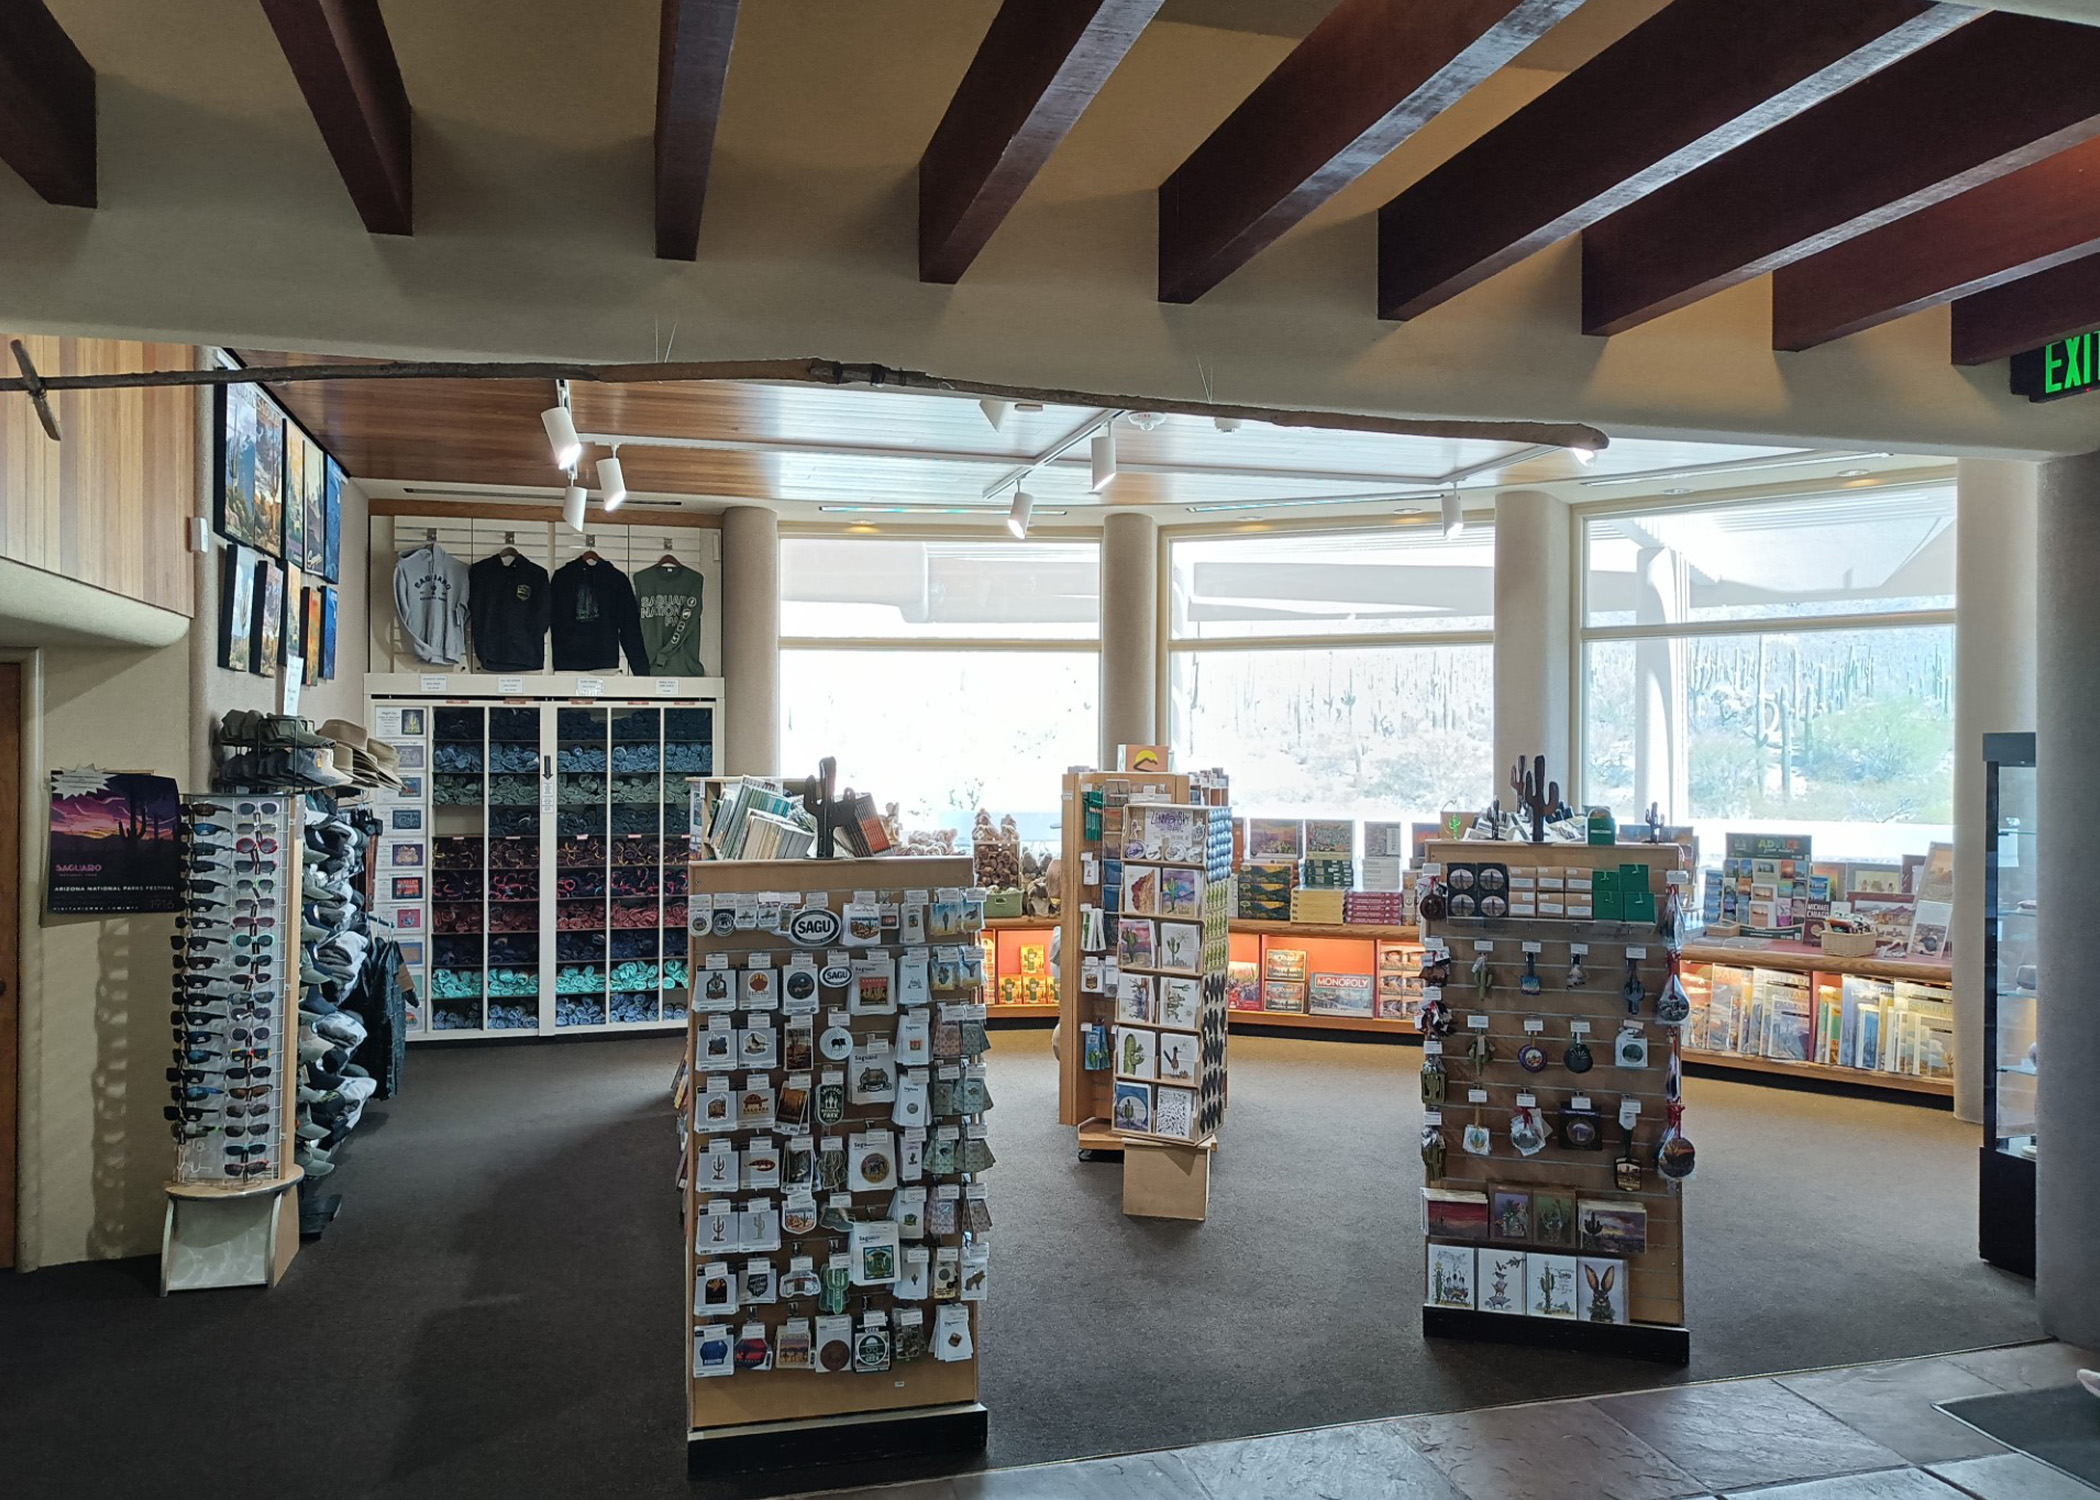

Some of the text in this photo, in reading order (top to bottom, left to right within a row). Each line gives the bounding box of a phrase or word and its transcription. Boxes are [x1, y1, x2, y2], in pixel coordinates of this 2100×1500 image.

[55, 863, 102, 872] SAGUARO
[1807, 903, 1830, 911] MICHAEL
[797, 920, 831, 935] SAGU
[826, 971, 848, 980] SAGU
[1316, 977, 1369, 988] MONOPOLY
